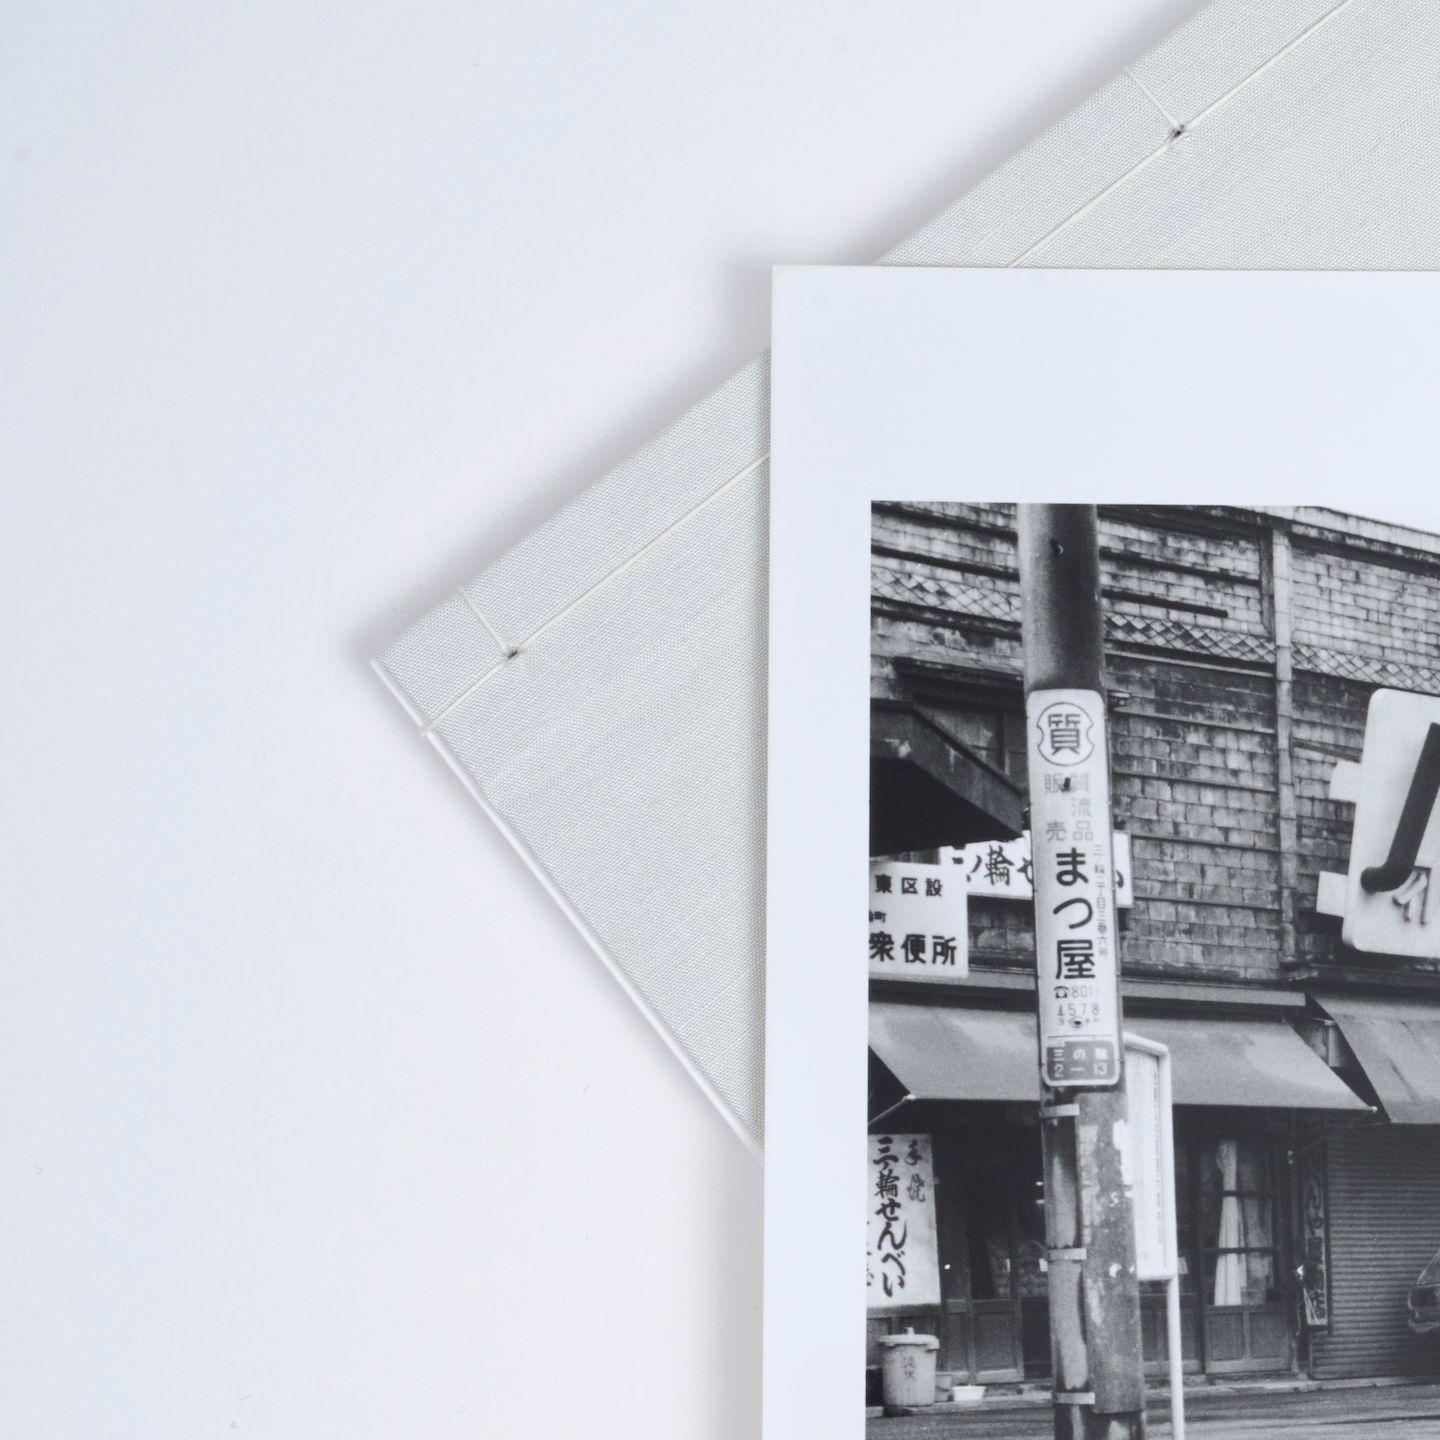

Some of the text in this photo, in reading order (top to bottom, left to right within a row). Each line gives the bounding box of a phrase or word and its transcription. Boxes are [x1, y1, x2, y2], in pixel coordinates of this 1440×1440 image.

[1047, 713, 1082, 756] 質
[1053, 846, 1096, 980] まつ屋
